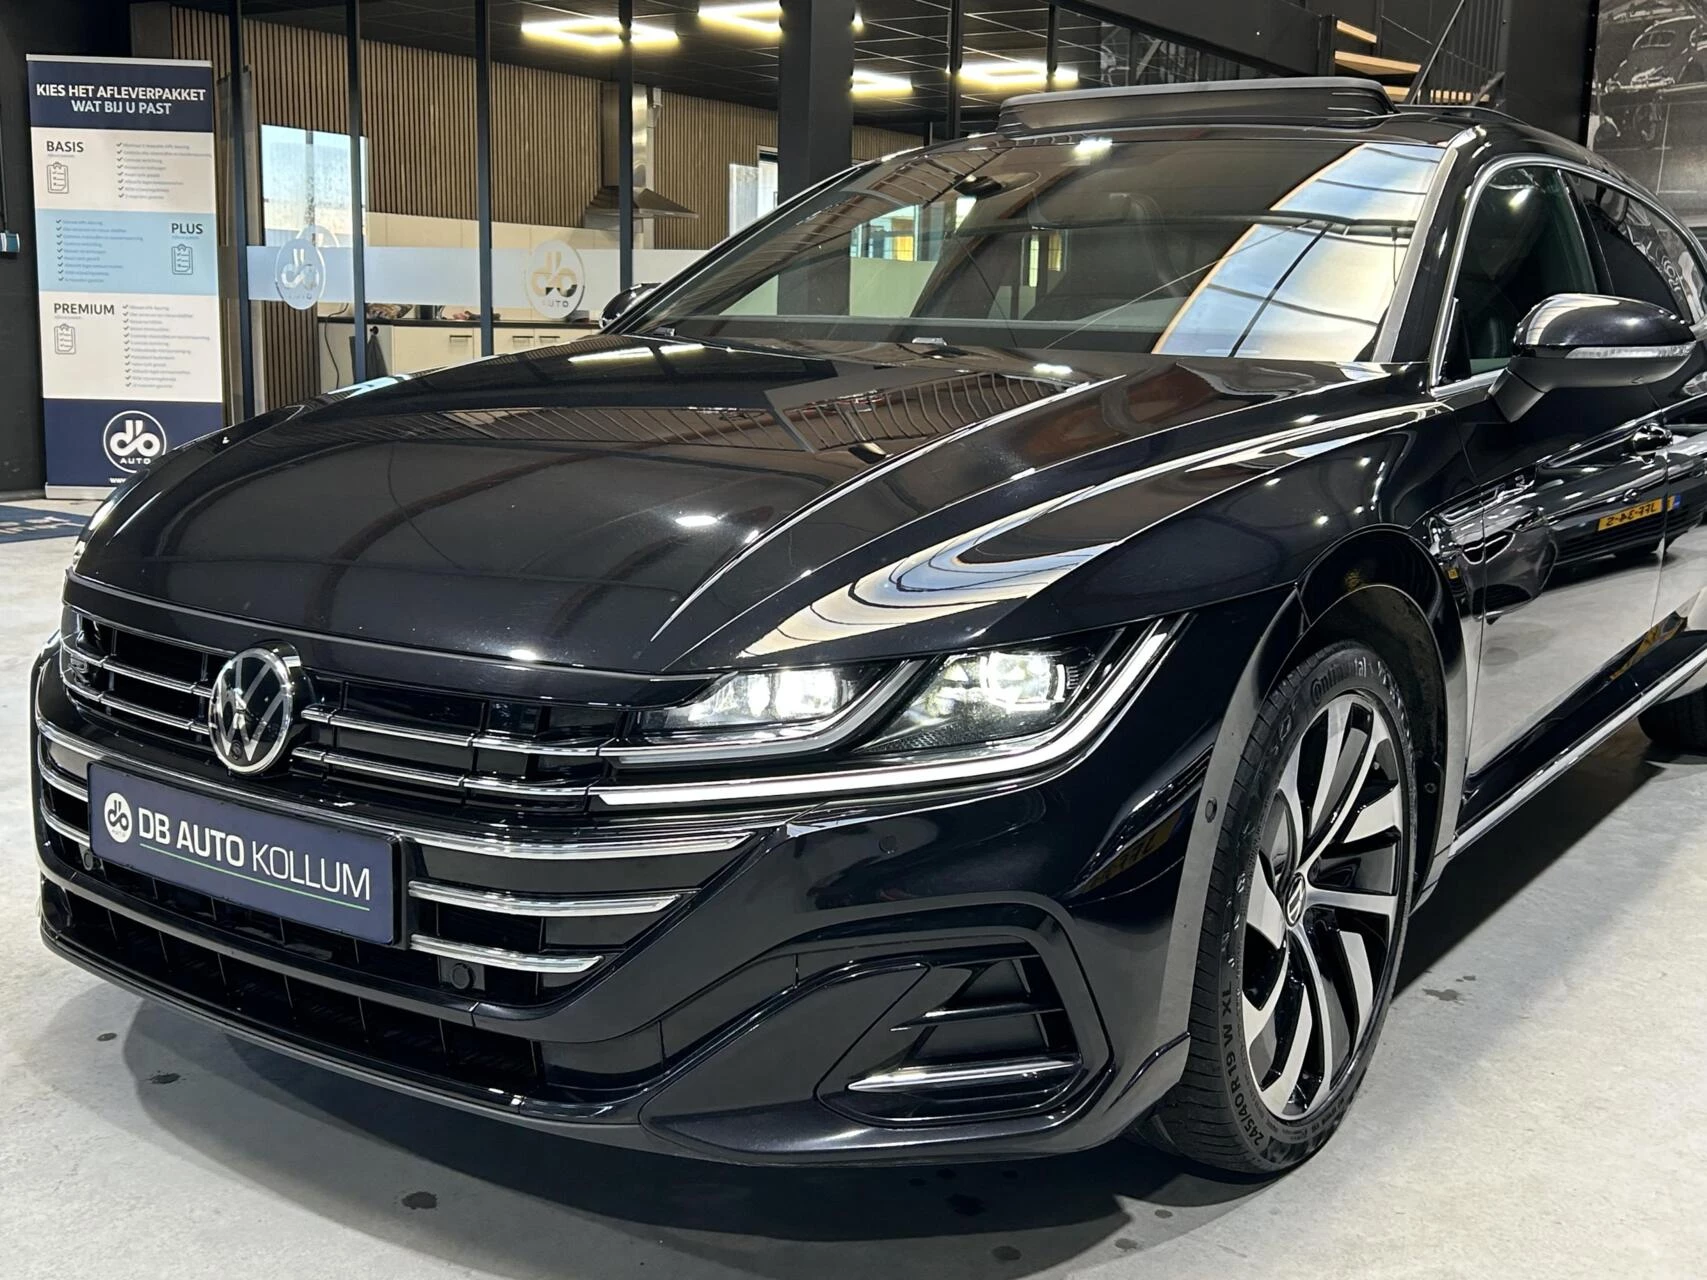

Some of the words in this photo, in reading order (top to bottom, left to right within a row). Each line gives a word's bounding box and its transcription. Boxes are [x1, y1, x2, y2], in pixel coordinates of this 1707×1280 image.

[36, 84, 66, 97] KIES
[69, 85, 95, 98] HET
[97, 86, 207, 101] AFLEVERPAKKET
[71, 100, 102, 112] WAT
[104, 101, 122, 113] BIJ
[126, 102, 135, 114] U
[139, 102, 172, 115] PAST
[46, 141, 84, 153] BASIS
[171, 223, 204, 235] PLUS
[53, 303, 115, 316] PREMIUM
[541, 300, 570, 308] UTO
[138, 807, 171, 845] DB
[177, 820, 244, 867] AUTO
[252, 841, 370, 900] KOLLUM
[1221, 980, 1232, 1016] XL
[1222, 1023, 1233, 1047] W
